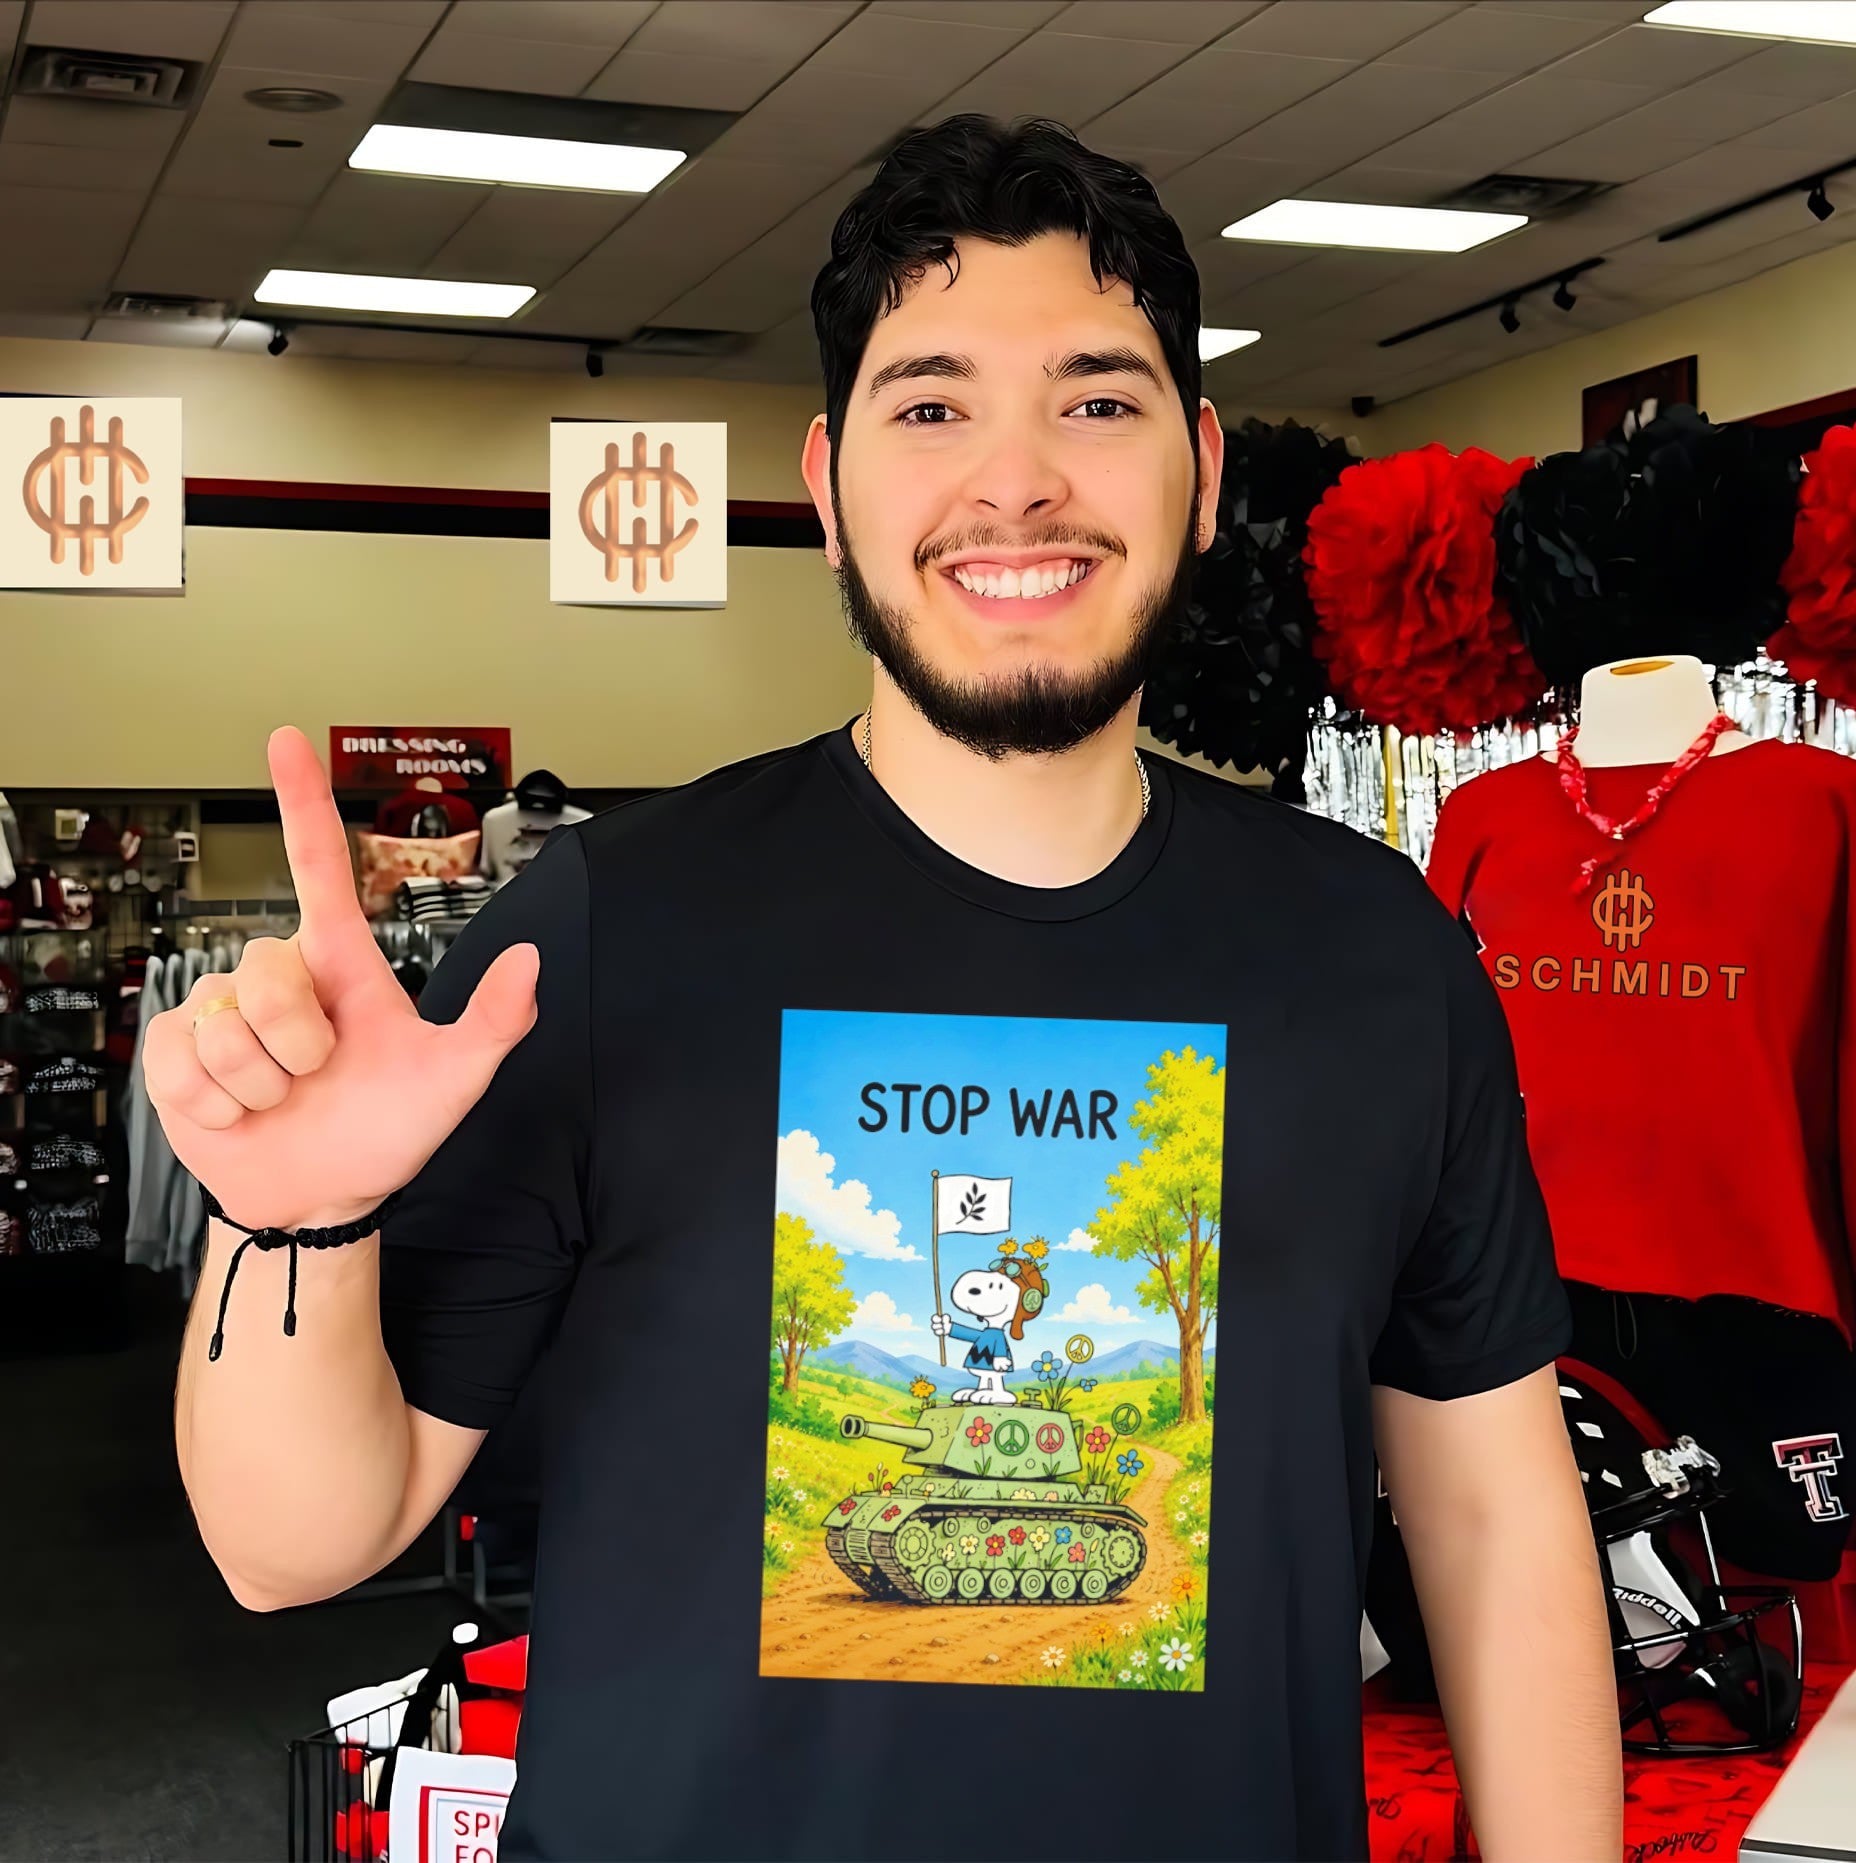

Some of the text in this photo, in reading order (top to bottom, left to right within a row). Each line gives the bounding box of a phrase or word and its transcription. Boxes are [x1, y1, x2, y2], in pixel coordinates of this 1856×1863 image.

[342, 737, 467, 753] DRESSING
[396, 758, 487, 774] ROOMS
[1494, 954, 1747, 1000] SCHMIDT
[858, 1081, 1119, 1141] STOP WAR
